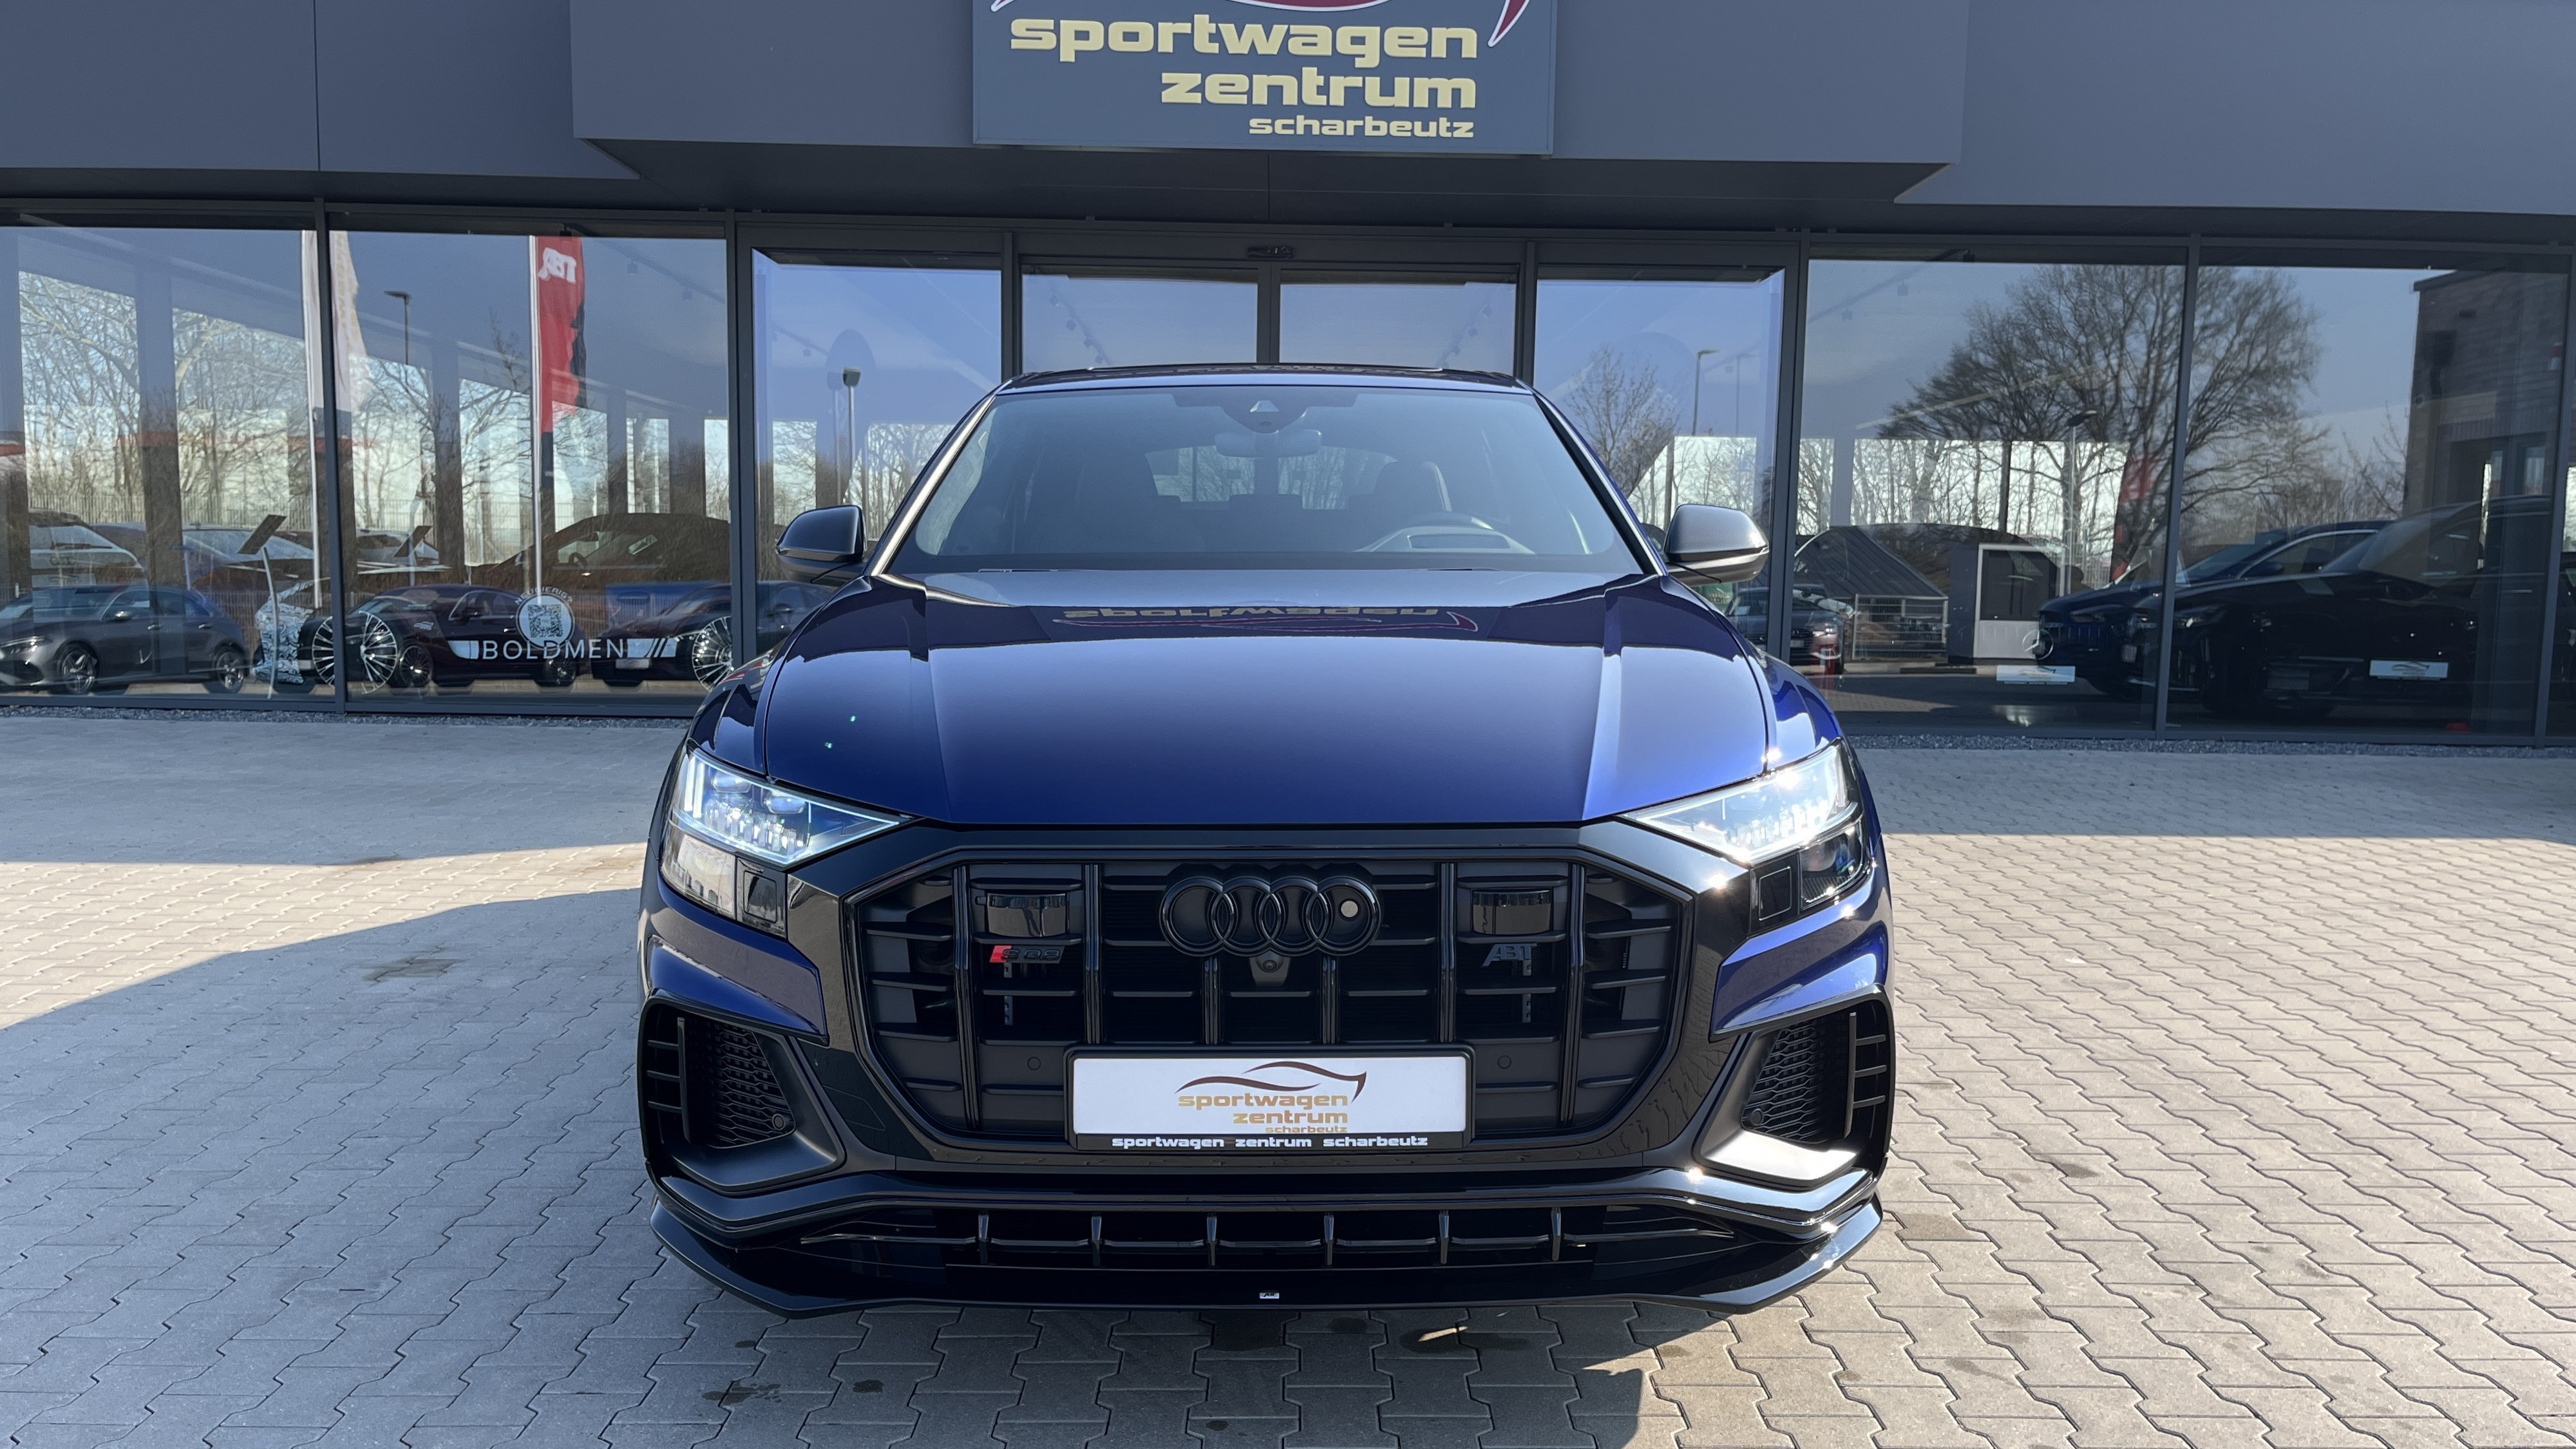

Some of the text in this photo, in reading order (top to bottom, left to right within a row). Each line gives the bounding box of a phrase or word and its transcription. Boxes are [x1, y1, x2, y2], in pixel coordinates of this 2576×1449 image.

[1011, 14, 1477, 68] sportwagen
[1161, 67, 1476, 108] zentrum
[1249, 115, 1474, 138] scharbeutz
[482, 639, 624, 659] BOLDMEN
[1001, 948, 1061, 960] SQ8
[1482, 943, 1537, 967] ABT
[1178, 1092, 1349, 1110] sportwagen
[1233, 1109, 1349, 1124] zentrum
[1112, 1135, 1428, 1150] sportwagen zentrum scharbeutz
